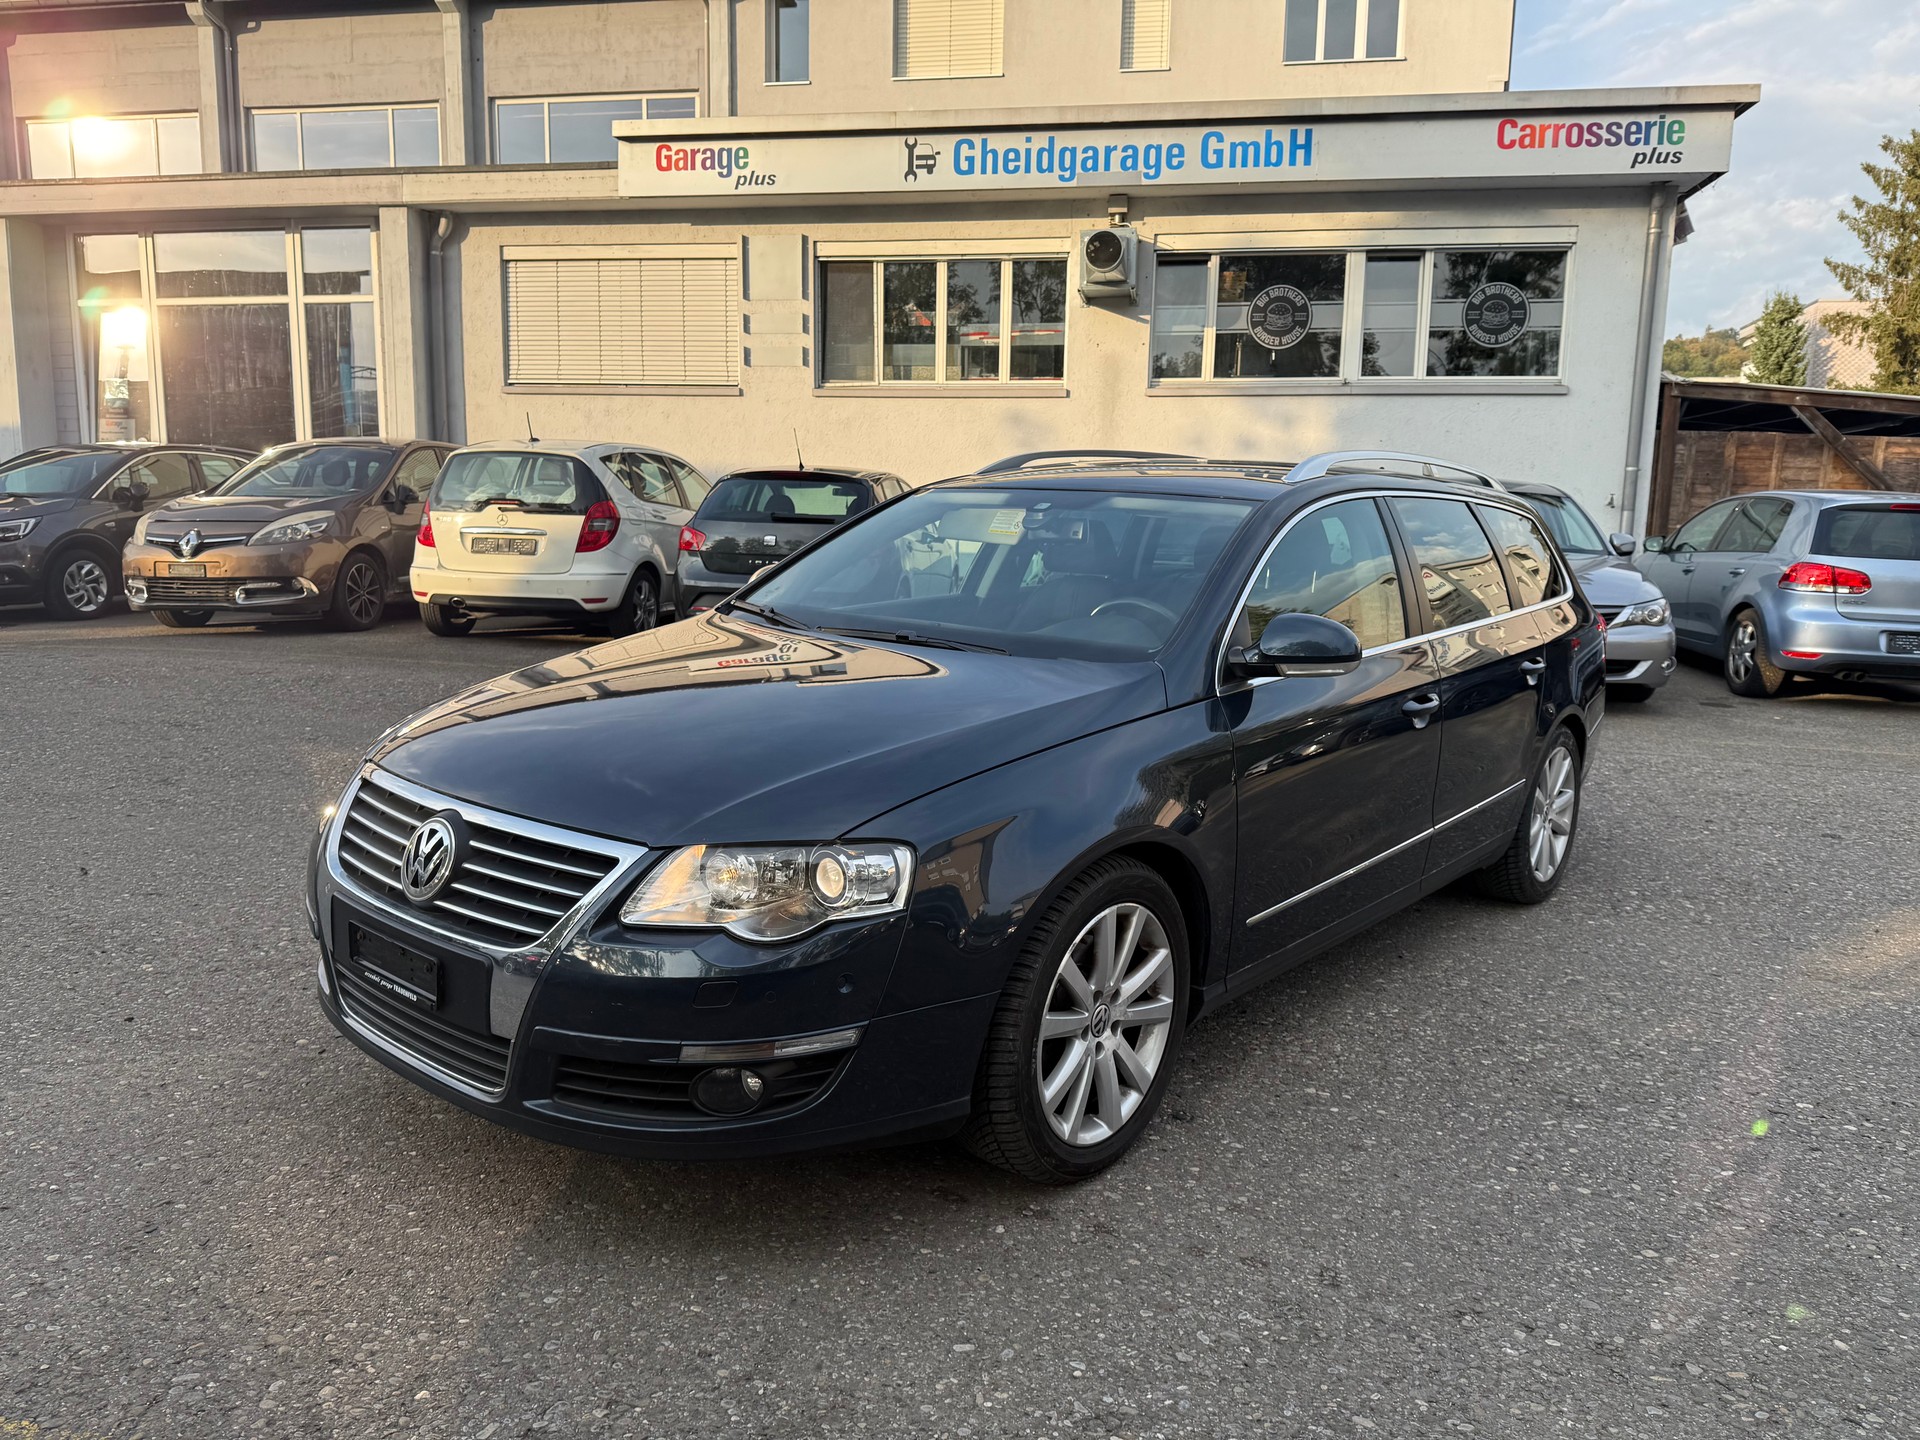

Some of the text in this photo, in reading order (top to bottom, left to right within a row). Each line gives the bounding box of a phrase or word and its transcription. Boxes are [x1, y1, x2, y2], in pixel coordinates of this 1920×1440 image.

[1497, 115, 1686, 150] Carrosserie
[656, 144, 749, 178] Garage
[953, 128, 1313, 182] Gheidgarage GmbH
[1630, 147, 1684, 168] plus
[734, 171, 776, 190] plus
[1256, 288, 1305, 308] BIG BROTHERS
[1471, 285, 1522, 305] BIG BROTHERS
[1253, 325, 1304, 346] BURGER HOUSE
[1469, 323, 1522, 344] BURGER HOUSE
